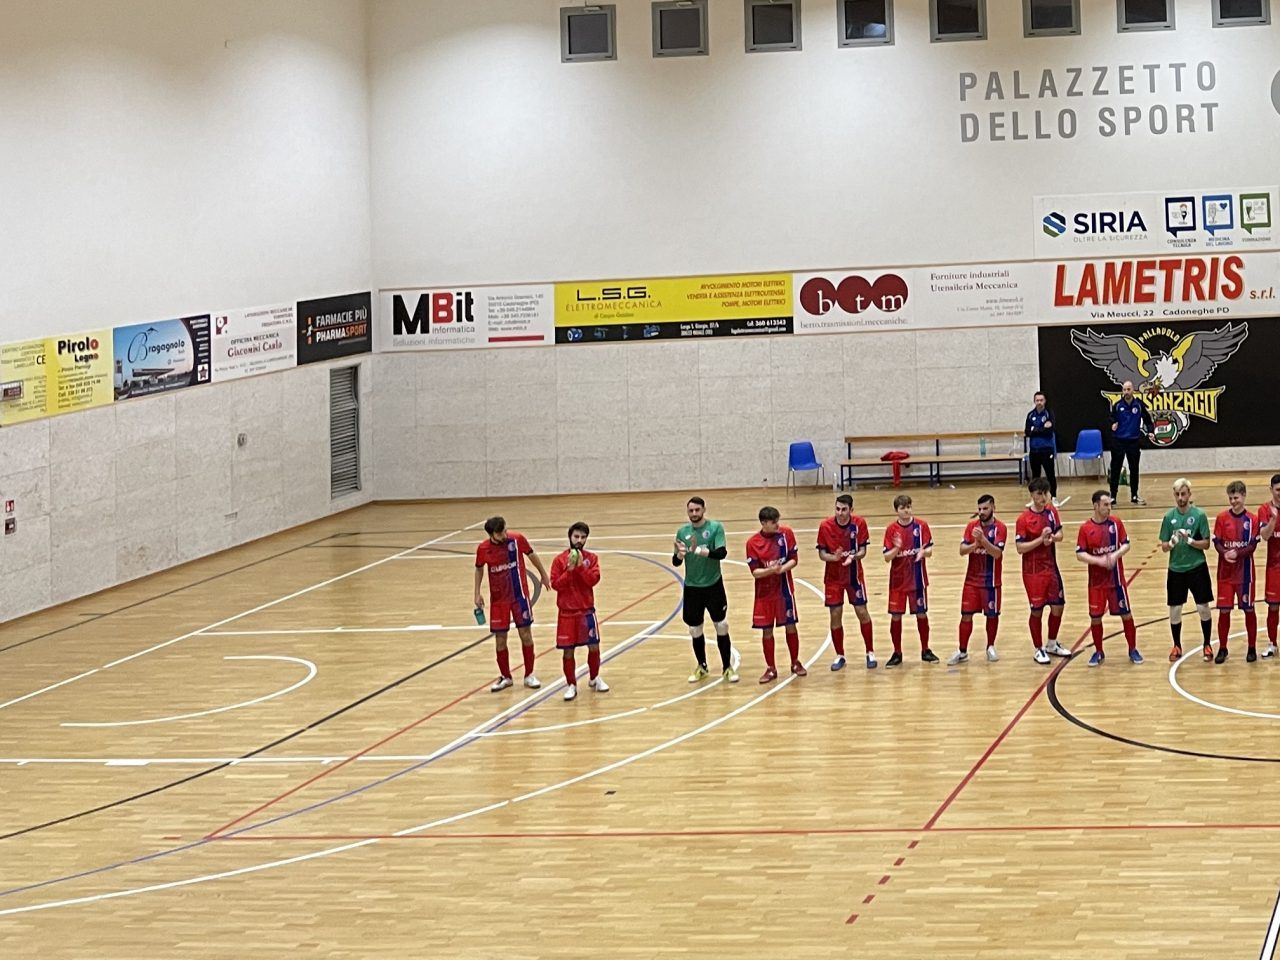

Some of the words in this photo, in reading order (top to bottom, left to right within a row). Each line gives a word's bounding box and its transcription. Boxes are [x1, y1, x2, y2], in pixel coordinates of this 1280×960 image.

[958, 60, 1217, 102] PALAZZETTO
[960, 108, 1078, 143] DELLO
[1098, 102, 1220, 138] SPORT
[1073, 210, 1148, 235] SIRIA
[1109, 233, 1148, 241] SICUREZZA
[930, 272, 968, 281] Forniture
[969, 270, 1010, 279] industriali
[1054, 255, 1245, 307] LAMETRIS
[1250, 287, 1276, 300] s.r.l.
[576, 286, 651, 301] L.S.G.
[930, 283, 974, 292] Utensileria
[975, 281, 1018, 290] Meccanica
[393, 292, 474, 335] MBit
[565, 300, 662, 312] ELETTROMECCANICA
[1107, 310, 1141, 318] Meucci,
[1162, 307, 1215, 316] Cadoneghe
[316, 311, 353, 327] FARMACIE
[355, 305, 368, 321] PIÙ
[316, 324, 367, 342] PHARMASPORT
[432, 325, 475, 334] informatica
[1138, 327, 1180, 344] PALLAVOLO
[57, 336, 99, 355] Pirolo
[230, 336, 253, 345] OFFICINA
[253, 332, 279, 342] MECCANICA
[393, 337, 426, 346] Soluzioni
[428, 337, 475, 345] informatiche
[127, 331, 185, 364] Brogagnolo
[227, 344, 261, 358] Giacomini
[262, 339, 283, 352] Carlo
[36, 354, 46, 365] CE
[74, 353, 99, 363] Legno
[1104, 389, 1223, 420] SANZAGO
